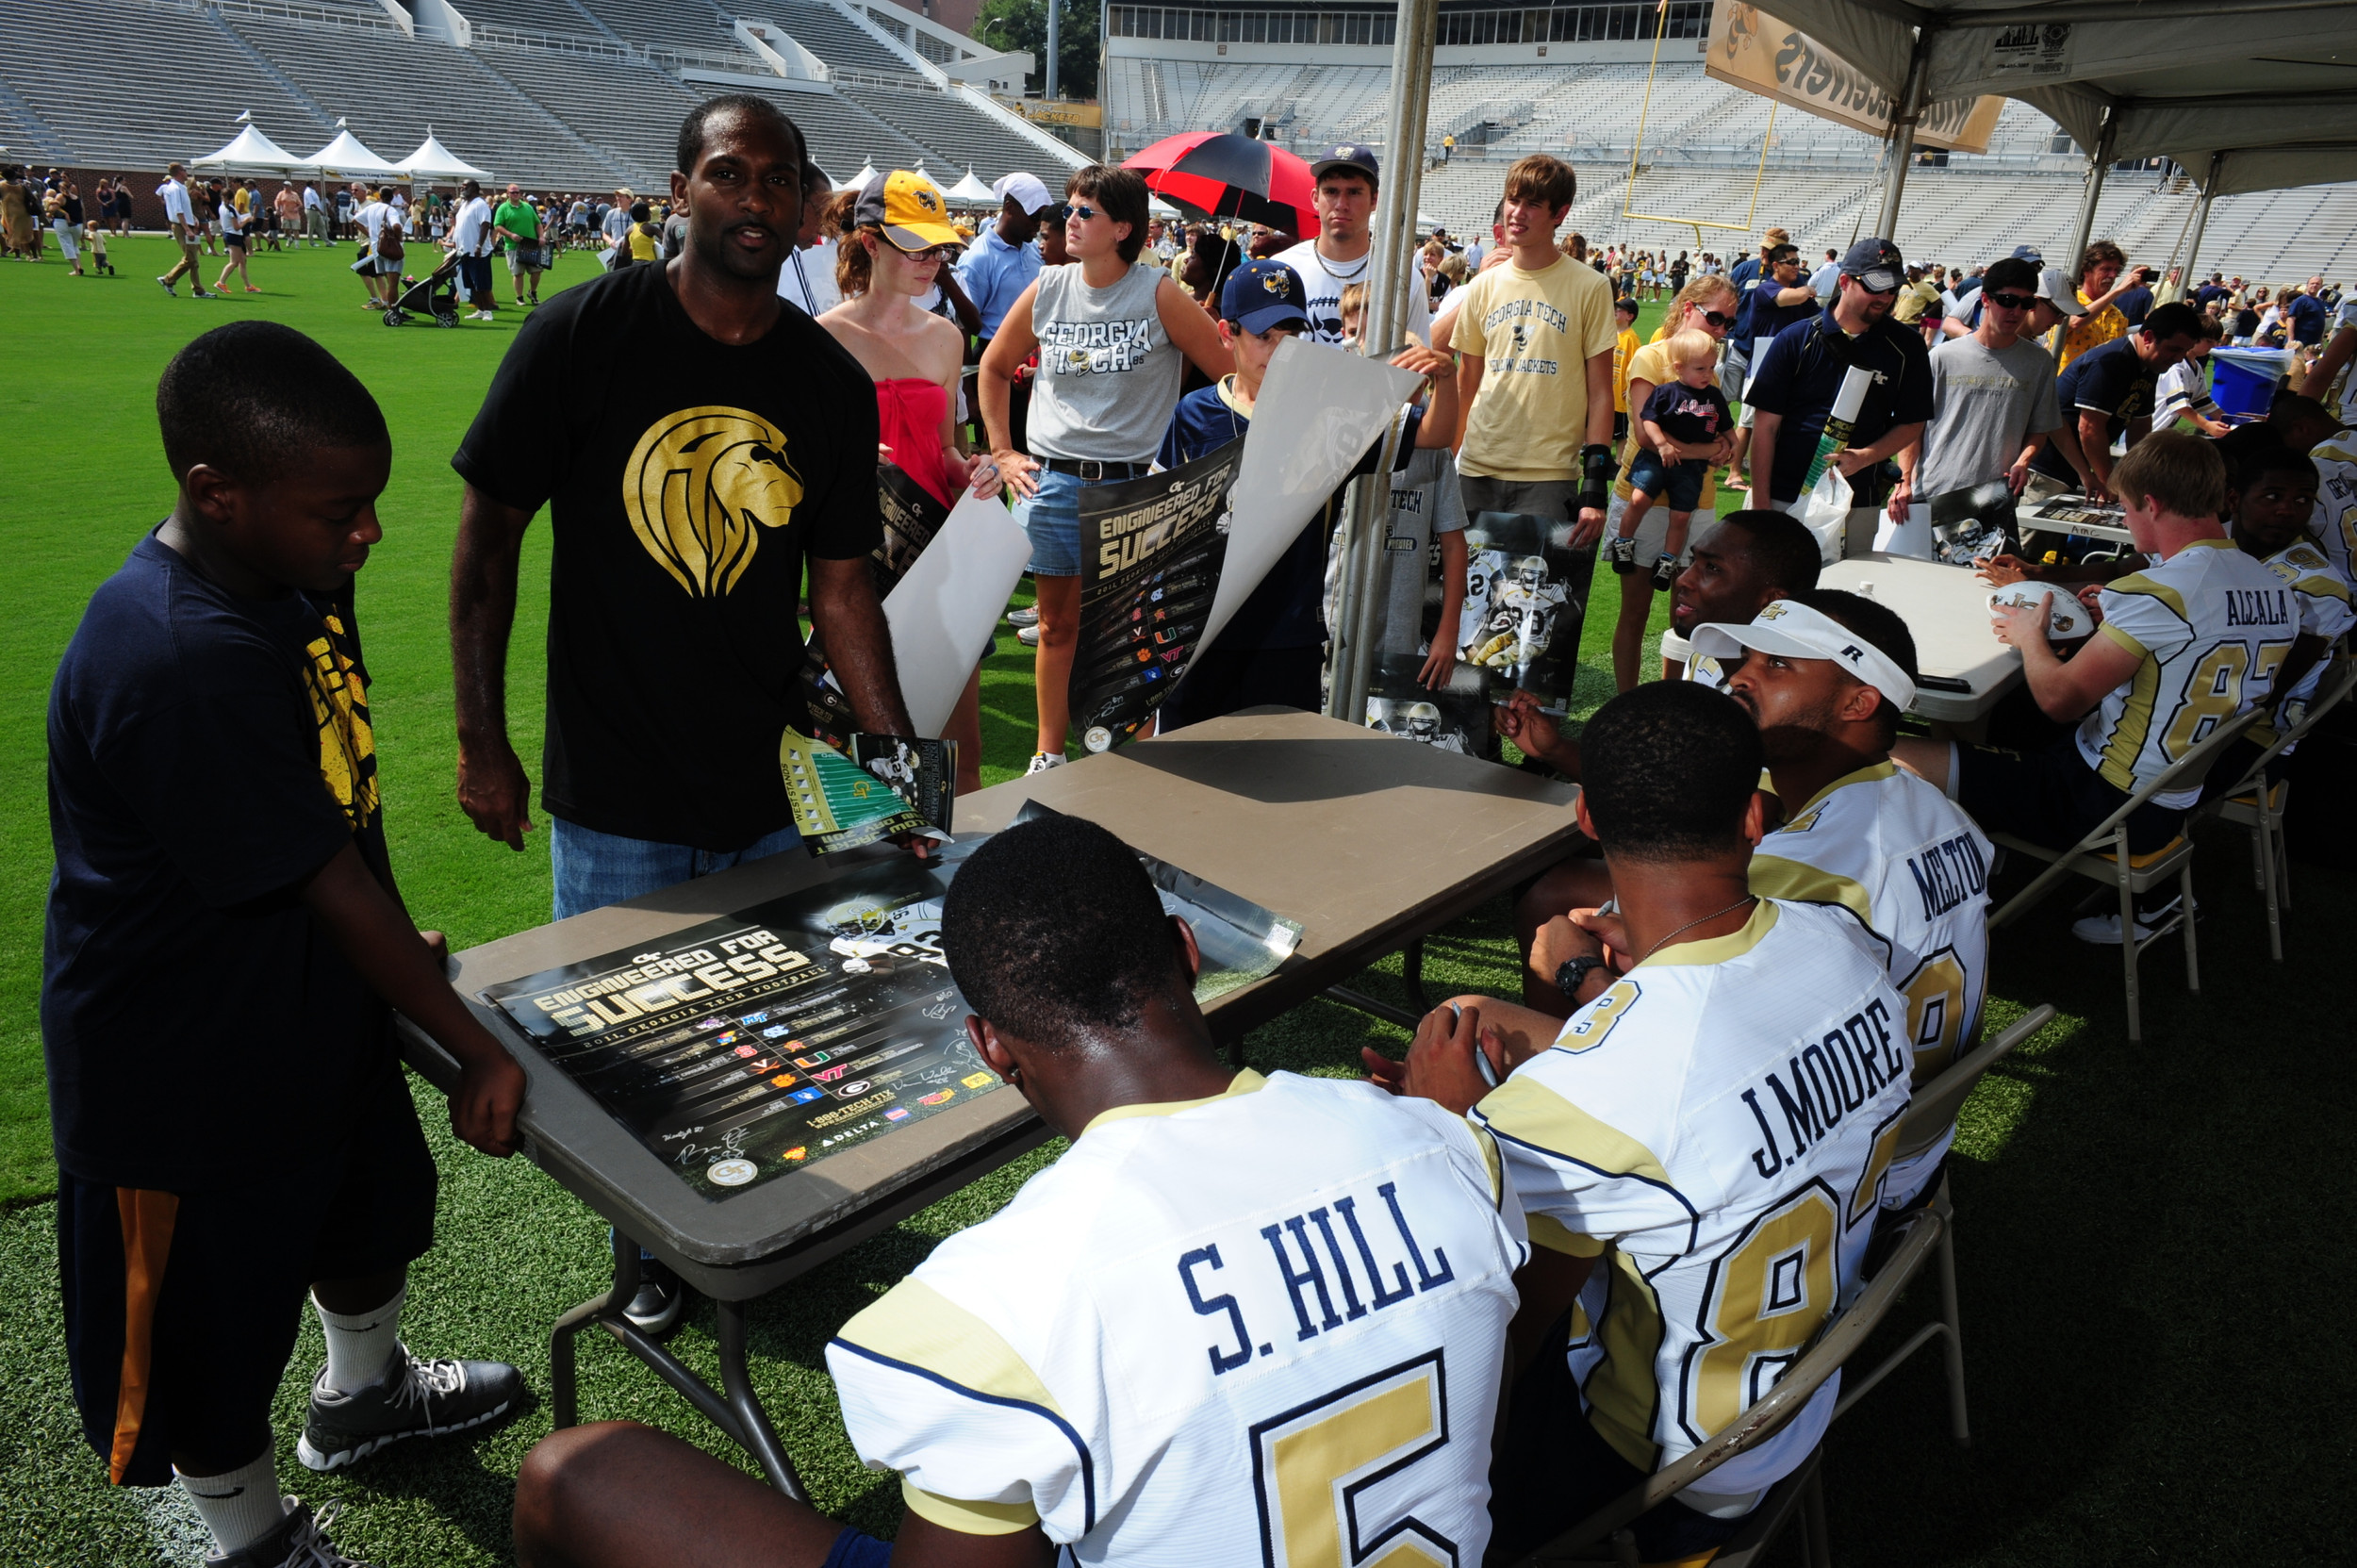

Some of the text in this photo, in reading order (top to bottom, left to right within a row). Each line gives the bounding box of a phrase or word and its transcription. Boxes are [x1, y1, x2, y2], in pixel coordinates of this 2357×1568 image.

[1028, 110, 1080, 124] JACKETS
[1486, 300, 1567, 334] GEORGIA TECH
[1044, 318, 1153, 354] GEORGIA
[1053, 341, 1132, 375] TCH
[1132, 355, 1145, 365] 85
[1516, 359, 1558, 375] JACKETS
[1099, 464, 1231, 540] ENGINEERED FOR
[1169, 481, 1185, 493] GT
[1390, 488, 1424, 515] TECH
[1099, 484, 1223, 580] SUCCESS
[1760, 602, 1788, 620] GT
[2225, 589, 2289, 627] ALCALA
[1840, 644, 1865, 668] R
[782, 763, 803, 822] WEST STANDS
[852, 781, 871, 800] GT
[930, 742, 940, 825] ENGINEERE
[1906, 831, 1986, 923] MELTON
[533, 930, 780, 1012] ENGINEERED FOR
[633, 951, 662, 966] GT
[551, 943, 812, 1037] SUCCESS
[583, 1033, 618, 1049] 2011
[628, 1007, 699, 1034] GEORGIA
[705, 992, 746, 1009] TECH
[752, 966, 827, 993] FOOTBALL
[741, 1012, 768, 1026] MT
[794, 1050, 832, 1068] U
[810, 1063, 848, 1082] VT
[1739, 998, 1905, 1179] J.MOORE
[806, 1088, 897, 1129] 1-888-TECH-TIX
[833, 1120, 881, 1142] DELTA
[715, 1163, 748, 1178] GT
[1177, 1180, 1457, 1377] S. HILL
[1248, 1346, 1461, 1568] 5
